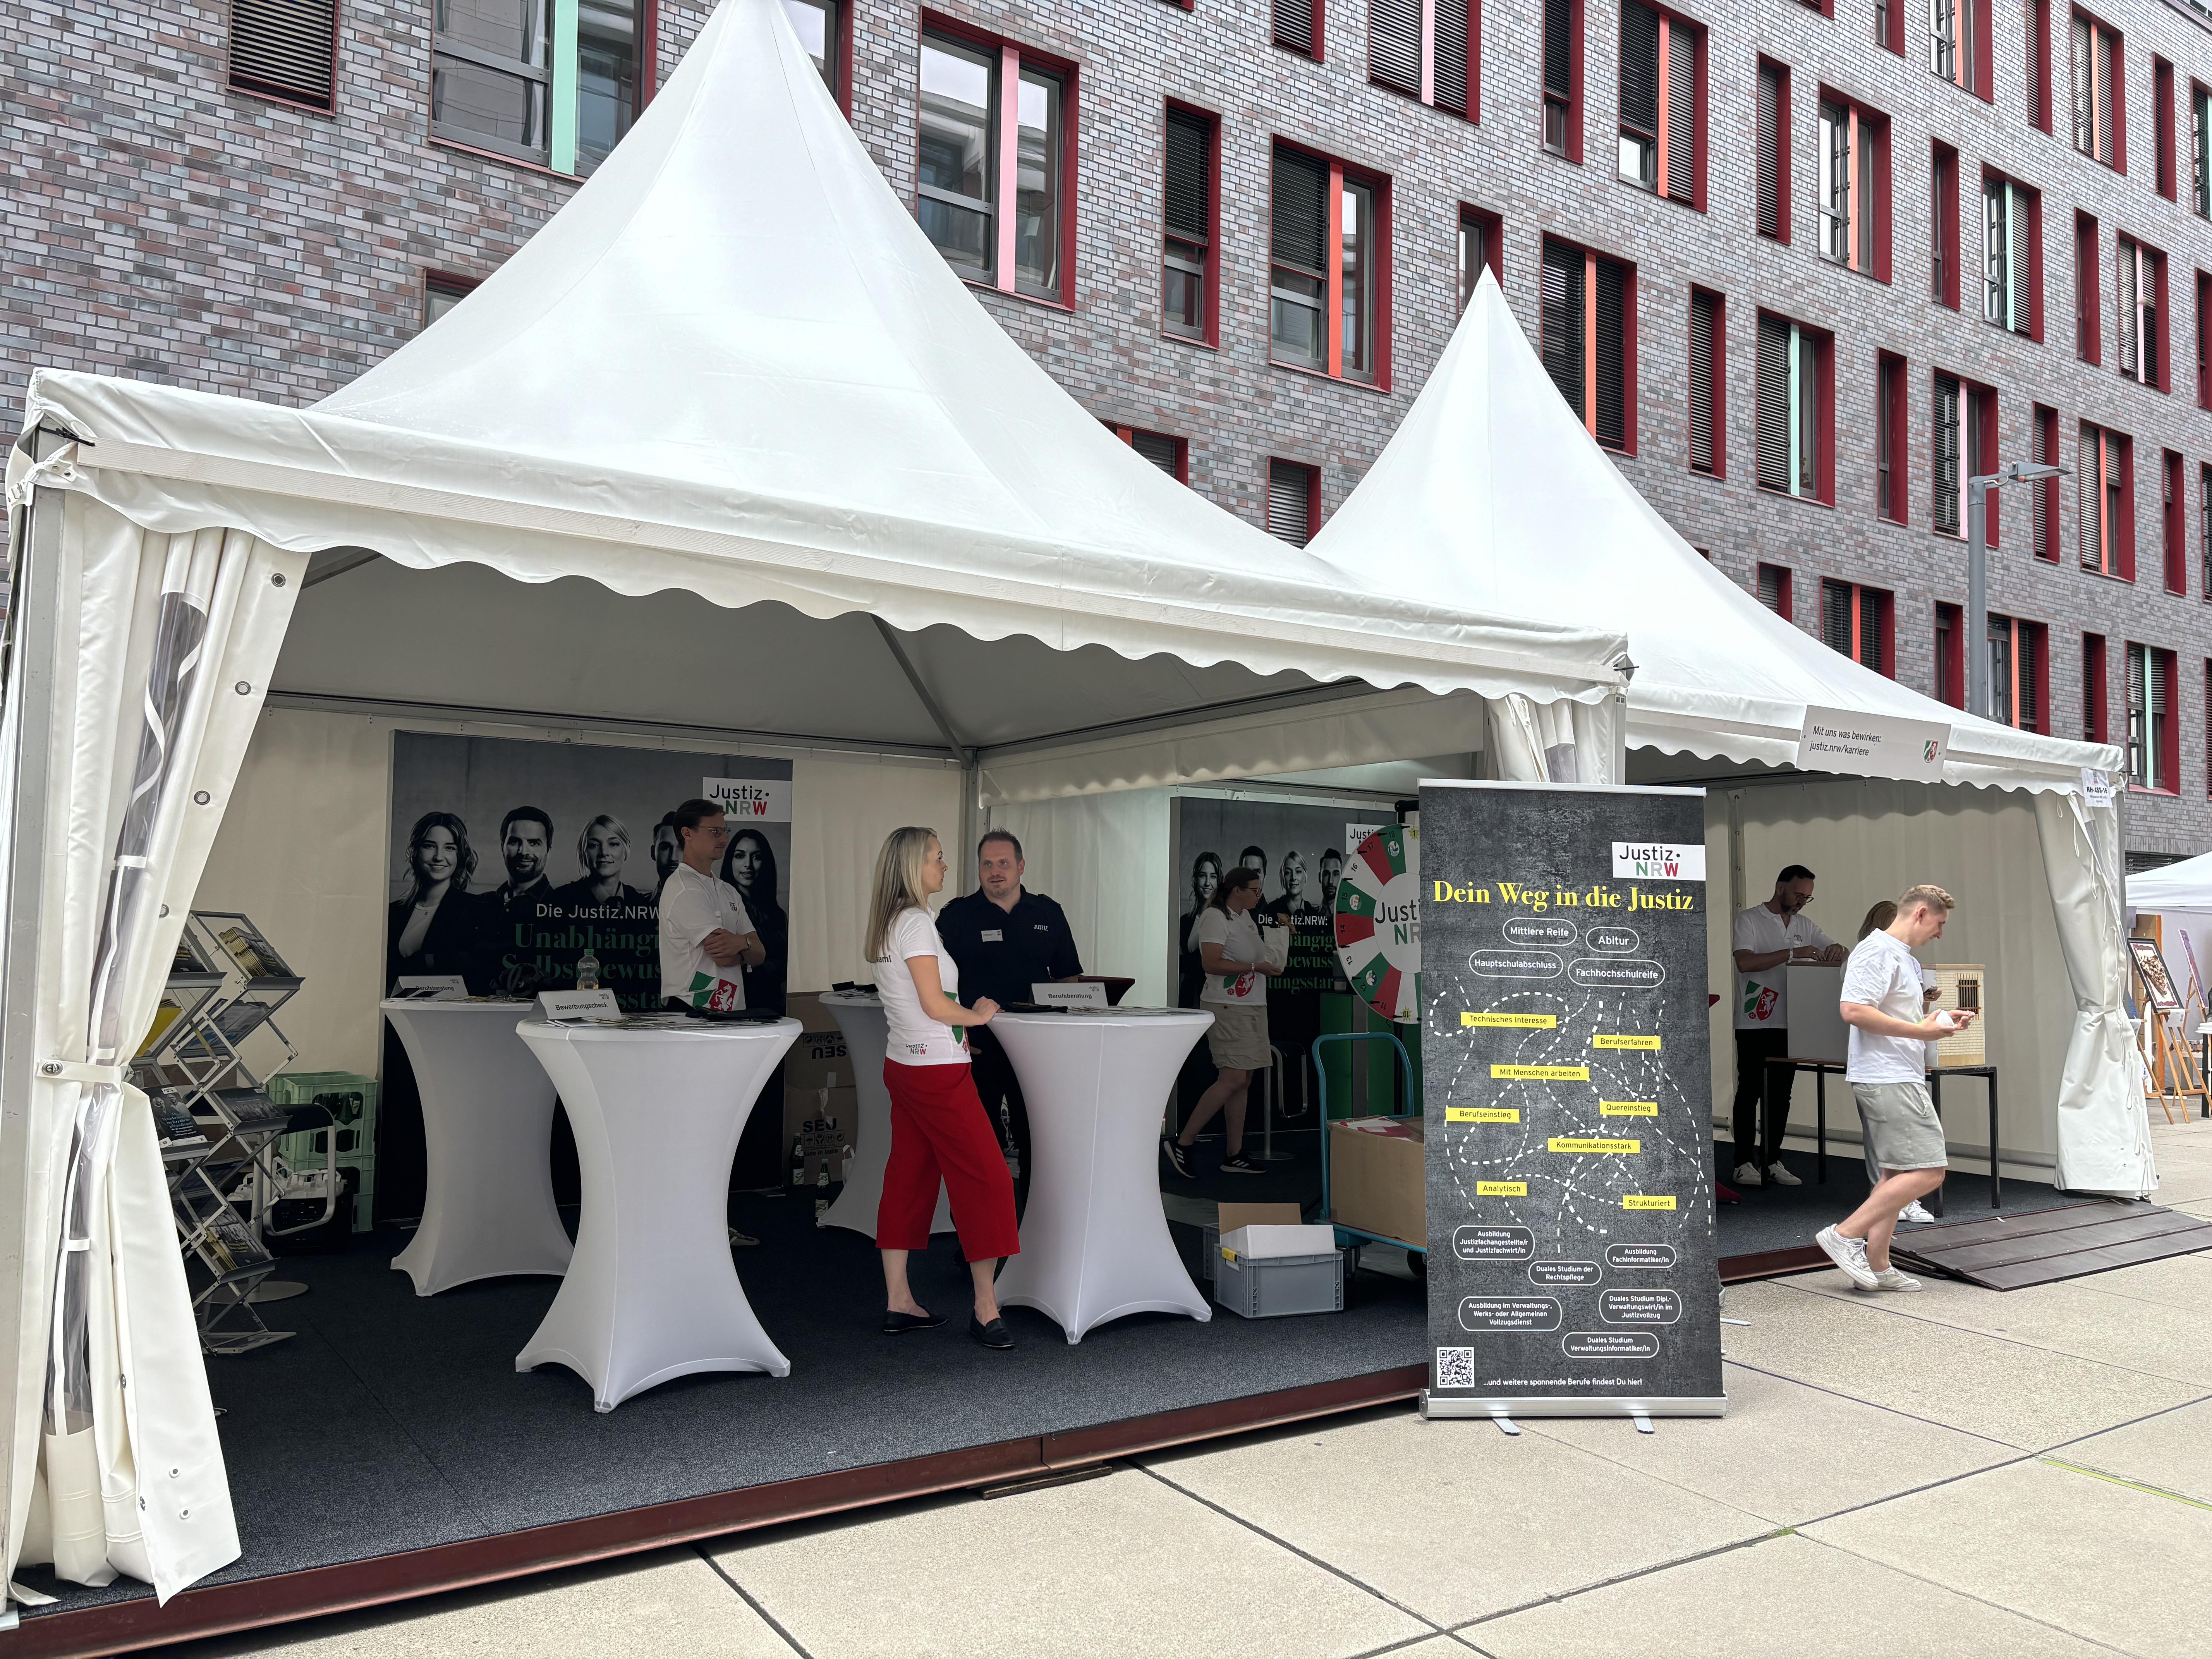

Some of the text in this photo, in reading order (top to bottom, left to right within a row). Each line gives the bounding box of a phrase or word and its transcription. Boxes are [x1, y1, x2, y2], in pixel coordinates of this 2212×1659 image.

[1813, 726, 1881, 743] Mit uns was bewirken:
[1809, 740, 1869, 756] justiz.nrw/karriere
[726, 800, 767, 815] NRW
[1351, 863, 1358, 872] 16
[1636, 862, 1678, 877] NRW
[1341, 892, 1348, 900] 15
[1433, 881, 1694, 912] Dein Weg in die Justiz
[536, 903, 562, 917] Die
[1259, 914, 1273, 924] Die
[1341, 924, 1345, 933] 14
[1510, 926, 1569, 937] Mittlere Reife
[1598, 936, 1629, 945] Abitur
[1346, 956, 1353, 965] 13
[1475, 959, 1556, 970] Hauptschulabschluss
[1576, 969, 1658, 979] Fachhochschulreife
[1470, 1015, 1512, 1024] Technisches
[1601, 1038, 1653, 1046] Berufserfahren
[1606, 1104, 1650, 1113] Quereinstieg
[1460, 1110, 1511, 1120] Berufseinstieg
[825, 1146, 838, 1155] India
[1483, 1185, 1521, 1193] Analytisch
[1460, 1239, 1528, 1247] Justizfachangestellte/r
[1475, 1246, 1526, 1255] Justizfachwirt/in
[1546, 1274, 1584, 1282] Rechtspflege
[1489, 1319, 1532, 1327] Vollzugsdienst
[1570, 1345, 1650, 1353] Verwaltungsinformatiker/in
[1530, 1379, 1566, 1387] spannende
